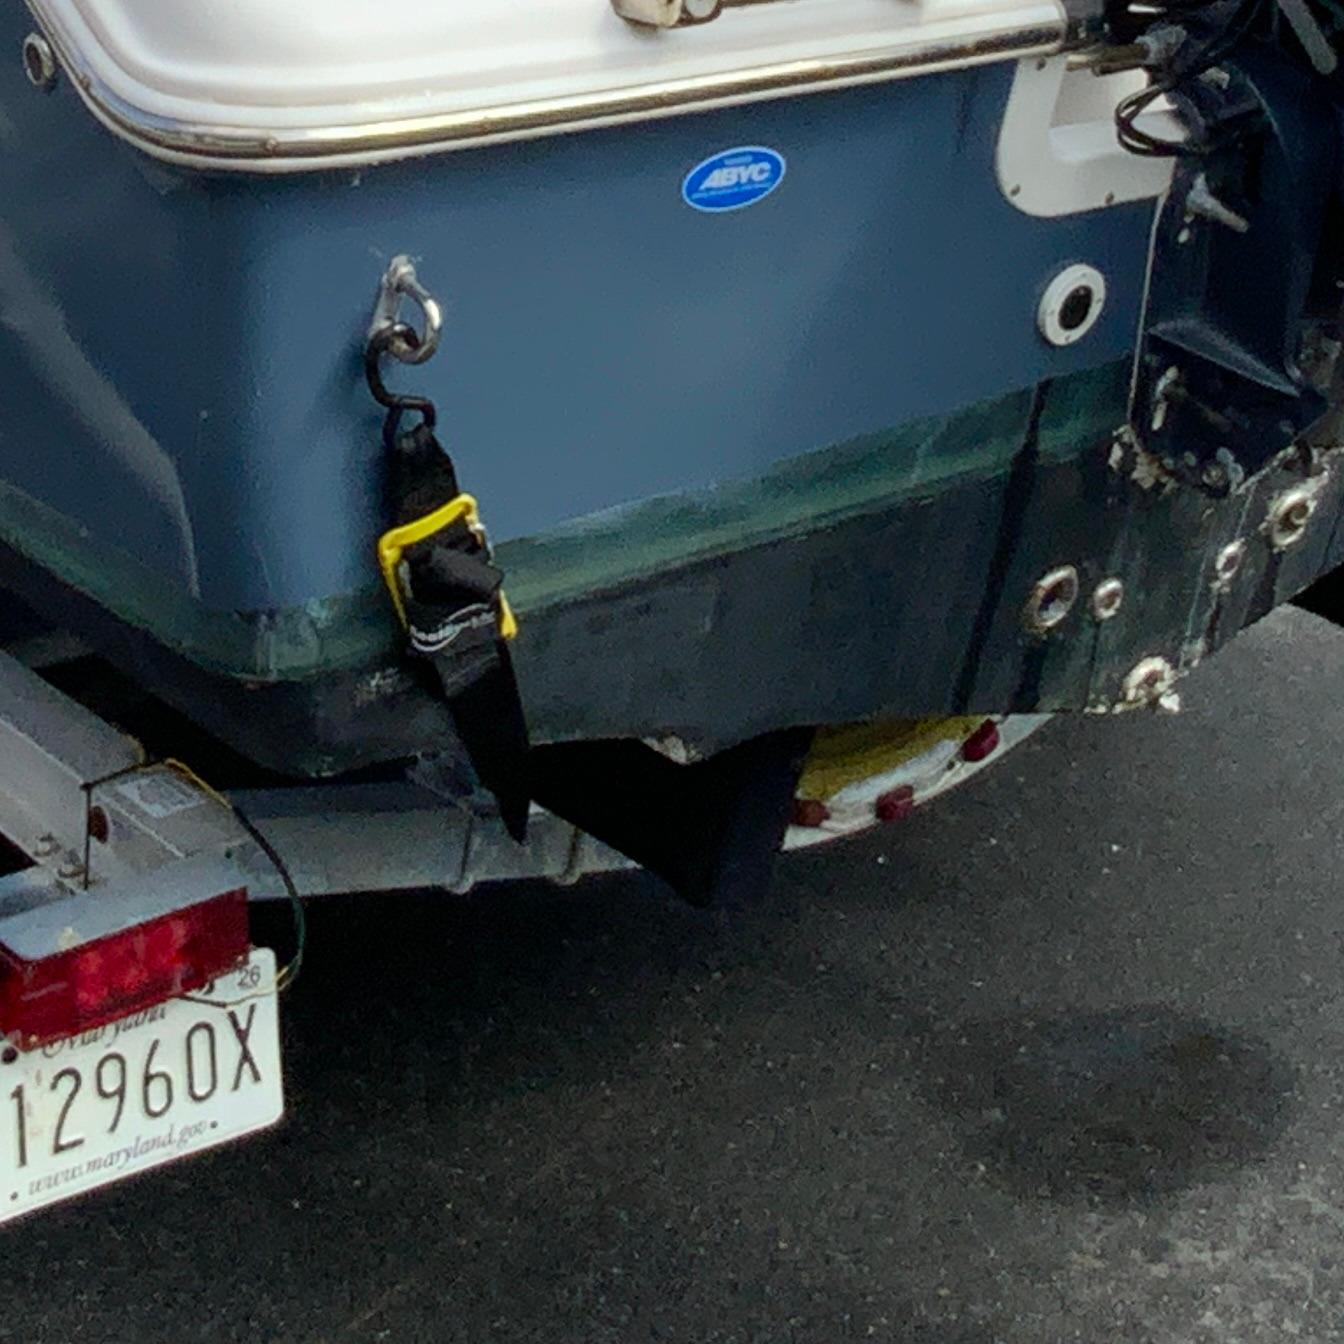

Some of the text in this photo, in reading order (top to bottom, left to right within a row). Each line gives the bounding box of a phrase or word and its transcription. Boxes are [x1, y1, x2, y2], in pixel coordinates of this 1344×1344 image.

[698, 161, 772, 191] ABYC
[237, 965, 262, 988] 26
[27, 1118, 207, 1197] www.maryland.gov
